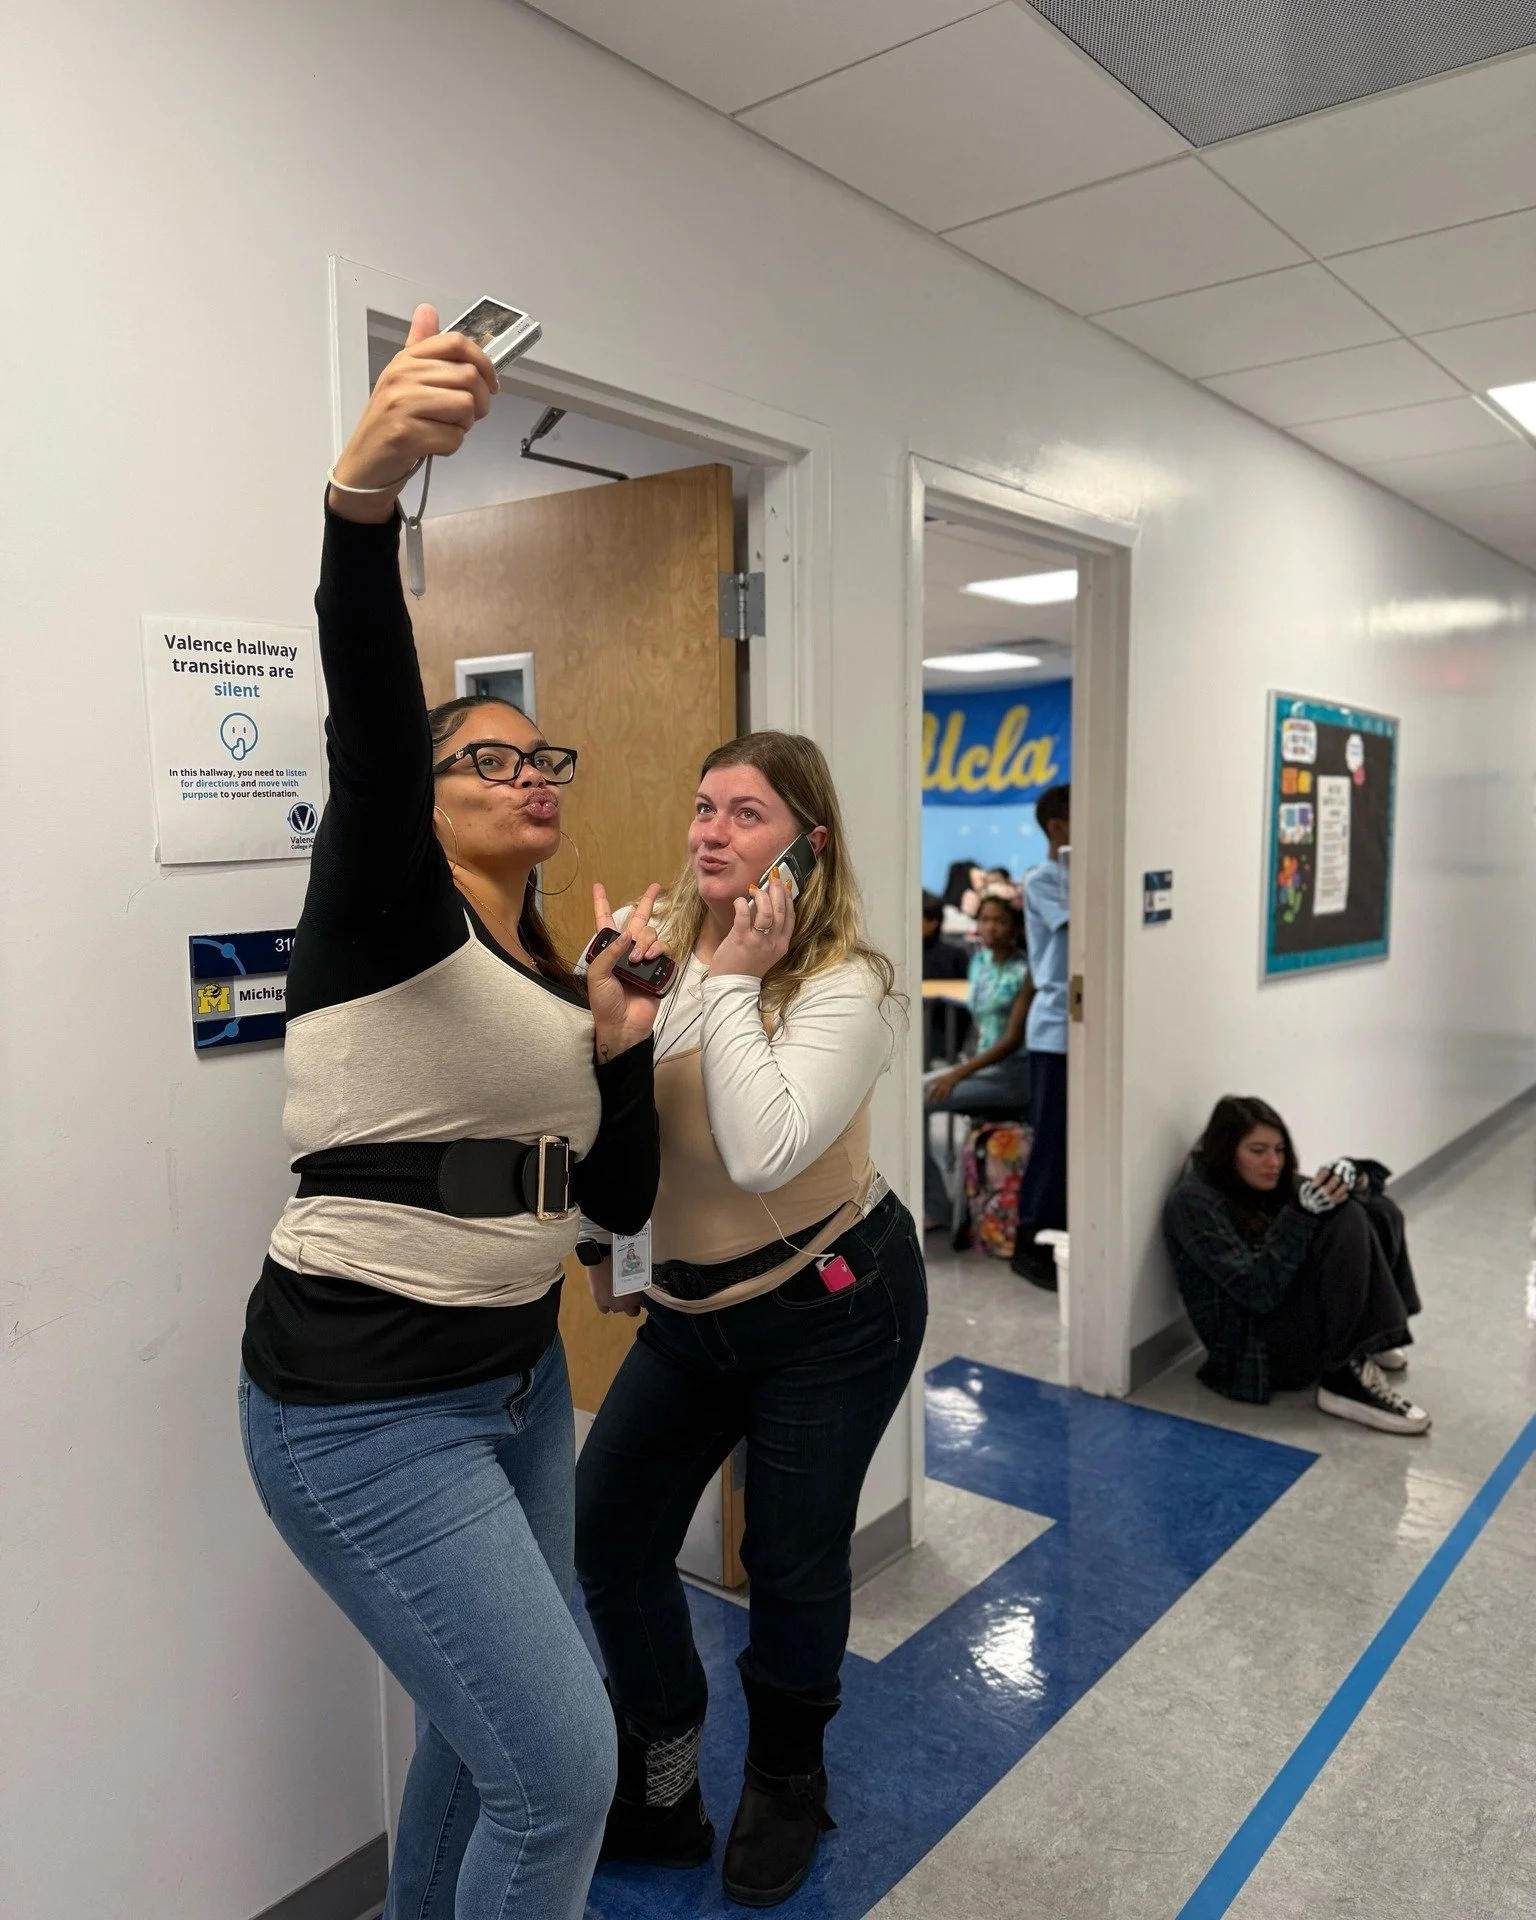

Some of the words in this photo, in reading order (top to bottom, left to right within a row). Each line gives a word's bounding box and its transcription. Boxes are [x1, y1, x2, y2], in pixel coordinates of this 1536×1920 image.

[164, 634, 232, 653] Valence
[237, 639, 297, 661] hallway
[172, 659, 264, 677] transitions
[269, 666, 294, 678] are
[214, 682, 260, 698] silent
[169, 769, 179, 777] In
[180, 769, 198, 777] this
[200, 769, 236, 778] hallway,
[255, 769, 274, 777] need
[285, 769, 307, 777] listen
[181, 780, 194, 788] for
[196, 780, 239, 788] directions
[241, 780, 256, 788] and
[281, 779, 299, 787] with
[182, 792, 218, 801] purpose
[231, 791, 250, 800] your
[252, 789, 299, 798] destination.
[290, 836, 315, 844] Valenc
[239, 987, 287, 1002] Michig
